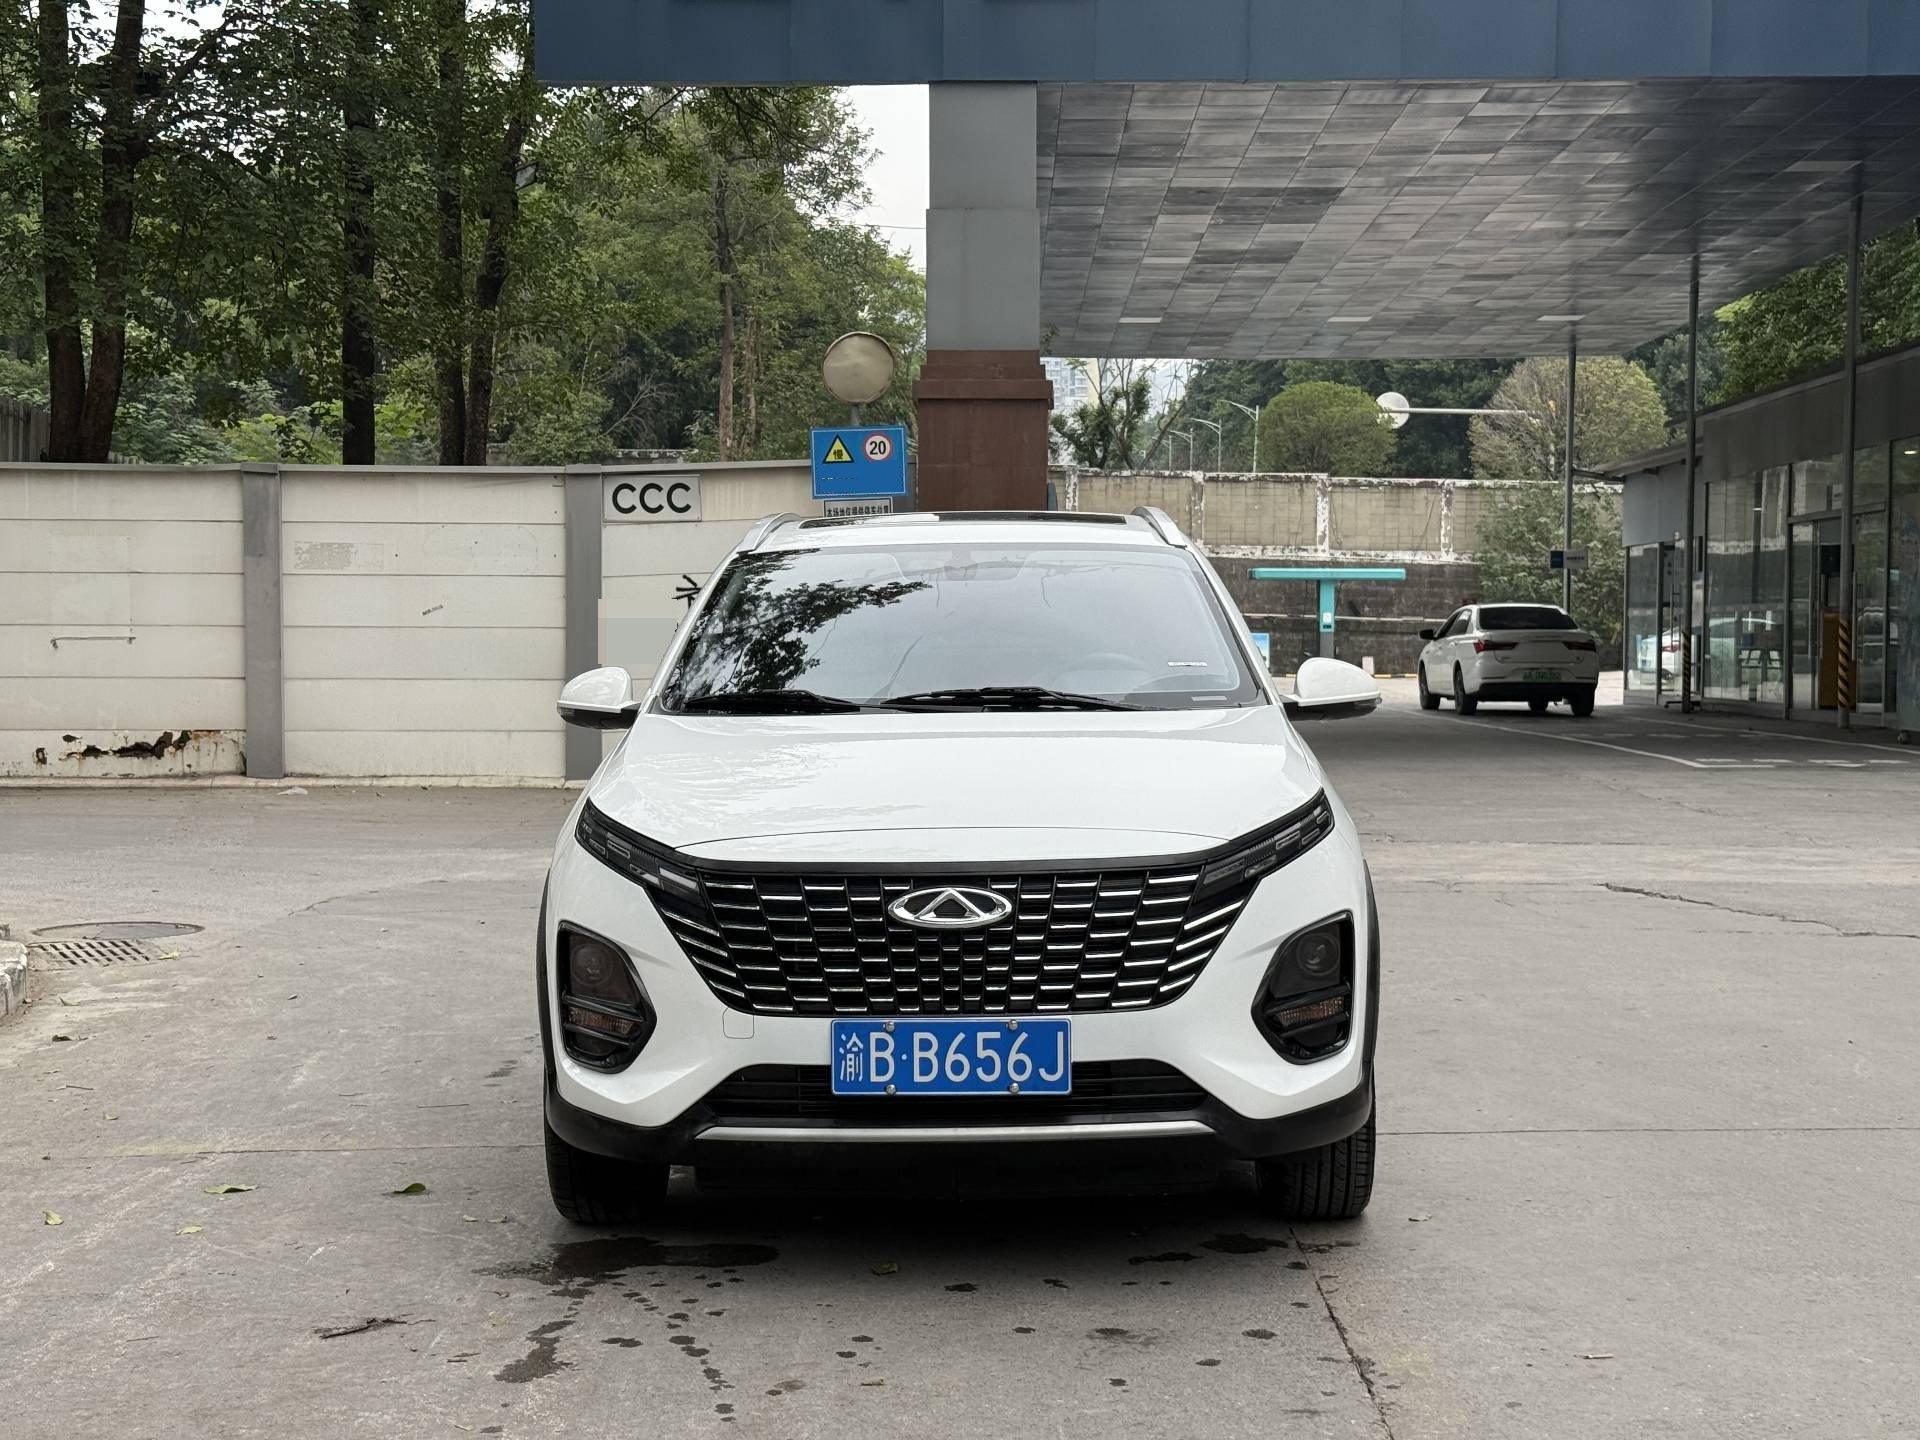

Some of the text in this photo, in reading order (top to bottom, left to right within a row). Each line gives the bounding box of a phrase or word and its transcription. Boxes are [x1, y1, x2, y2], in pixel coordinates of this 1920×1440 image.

[833, 449, 844, 460] 慢
[869, 440, 887, 455] 20
[612, 482, 692, 515] CCC
